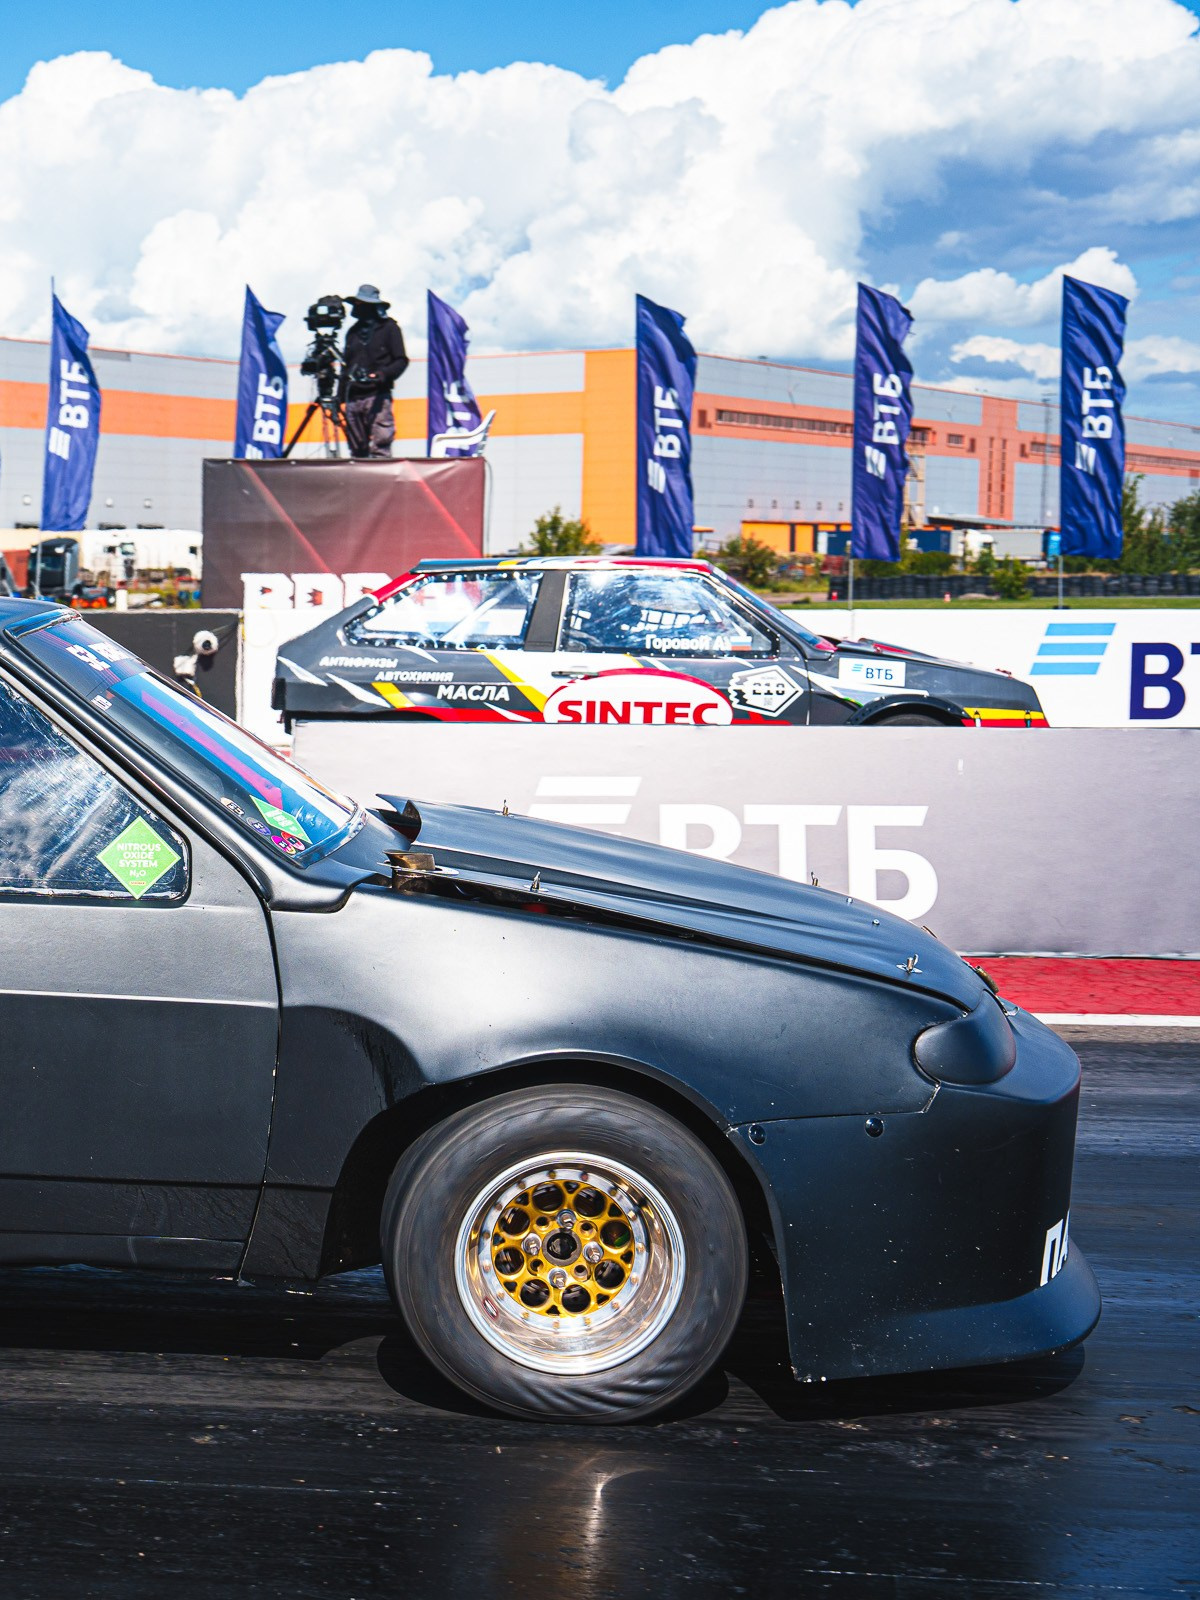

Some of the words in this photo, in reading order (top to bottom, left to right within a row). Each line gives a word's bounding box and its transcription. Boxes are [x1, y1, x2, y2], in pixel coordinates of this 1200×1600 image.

[59, 358, 90, 429] ВТБ
[1082, 366, 1114, 438] ВТБ
[253, 373, 284, 445] ВТБ
[873, 373, 903, 445] ВТБ
[653, 385, 683, 459] ВТБ
[645, 633, 711, 653] Горовой
[318, 656, 399, 668] АНТИФРИЗЫ
[374, 671, 454, 682] АВТОХИМИЯ
[865, 667, 893, 680] ВТБ
[1129, 642, 1200, 720] В
[436, 685, 510, 701] МАСЛА
[557, 700, 719, 724] SINTEC
[116, 842, 161, 852] NITROUS
[122, 852, 155, 860] OXIDE
[118, 860, 158, 868] SYSTEM
